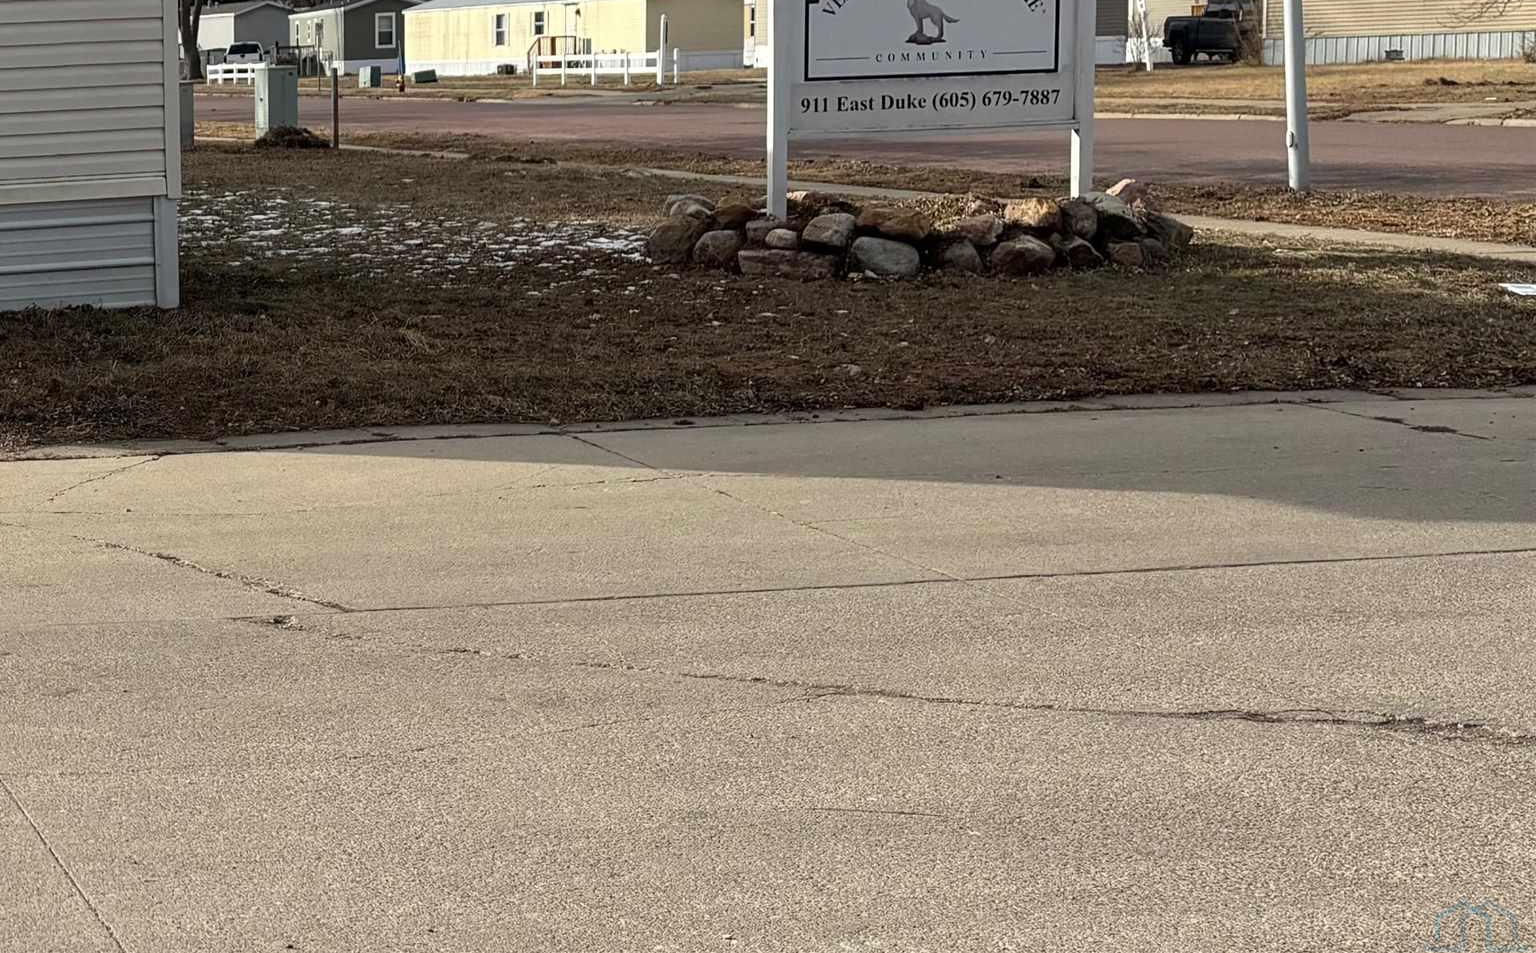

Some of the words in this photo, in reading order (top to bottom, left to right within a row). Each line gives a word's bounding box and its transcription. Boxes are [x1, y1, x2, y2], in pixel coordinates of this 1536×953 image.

[875, 49, 987, 63] COMMUNITY
[801, 96, 828, 113] 911
[837, 96, 874, 112] East
[881, 94, 927, 110] Duke
[932, 91, 976, 111] (605)
[982, 89, 1060, 106] 679-7887
